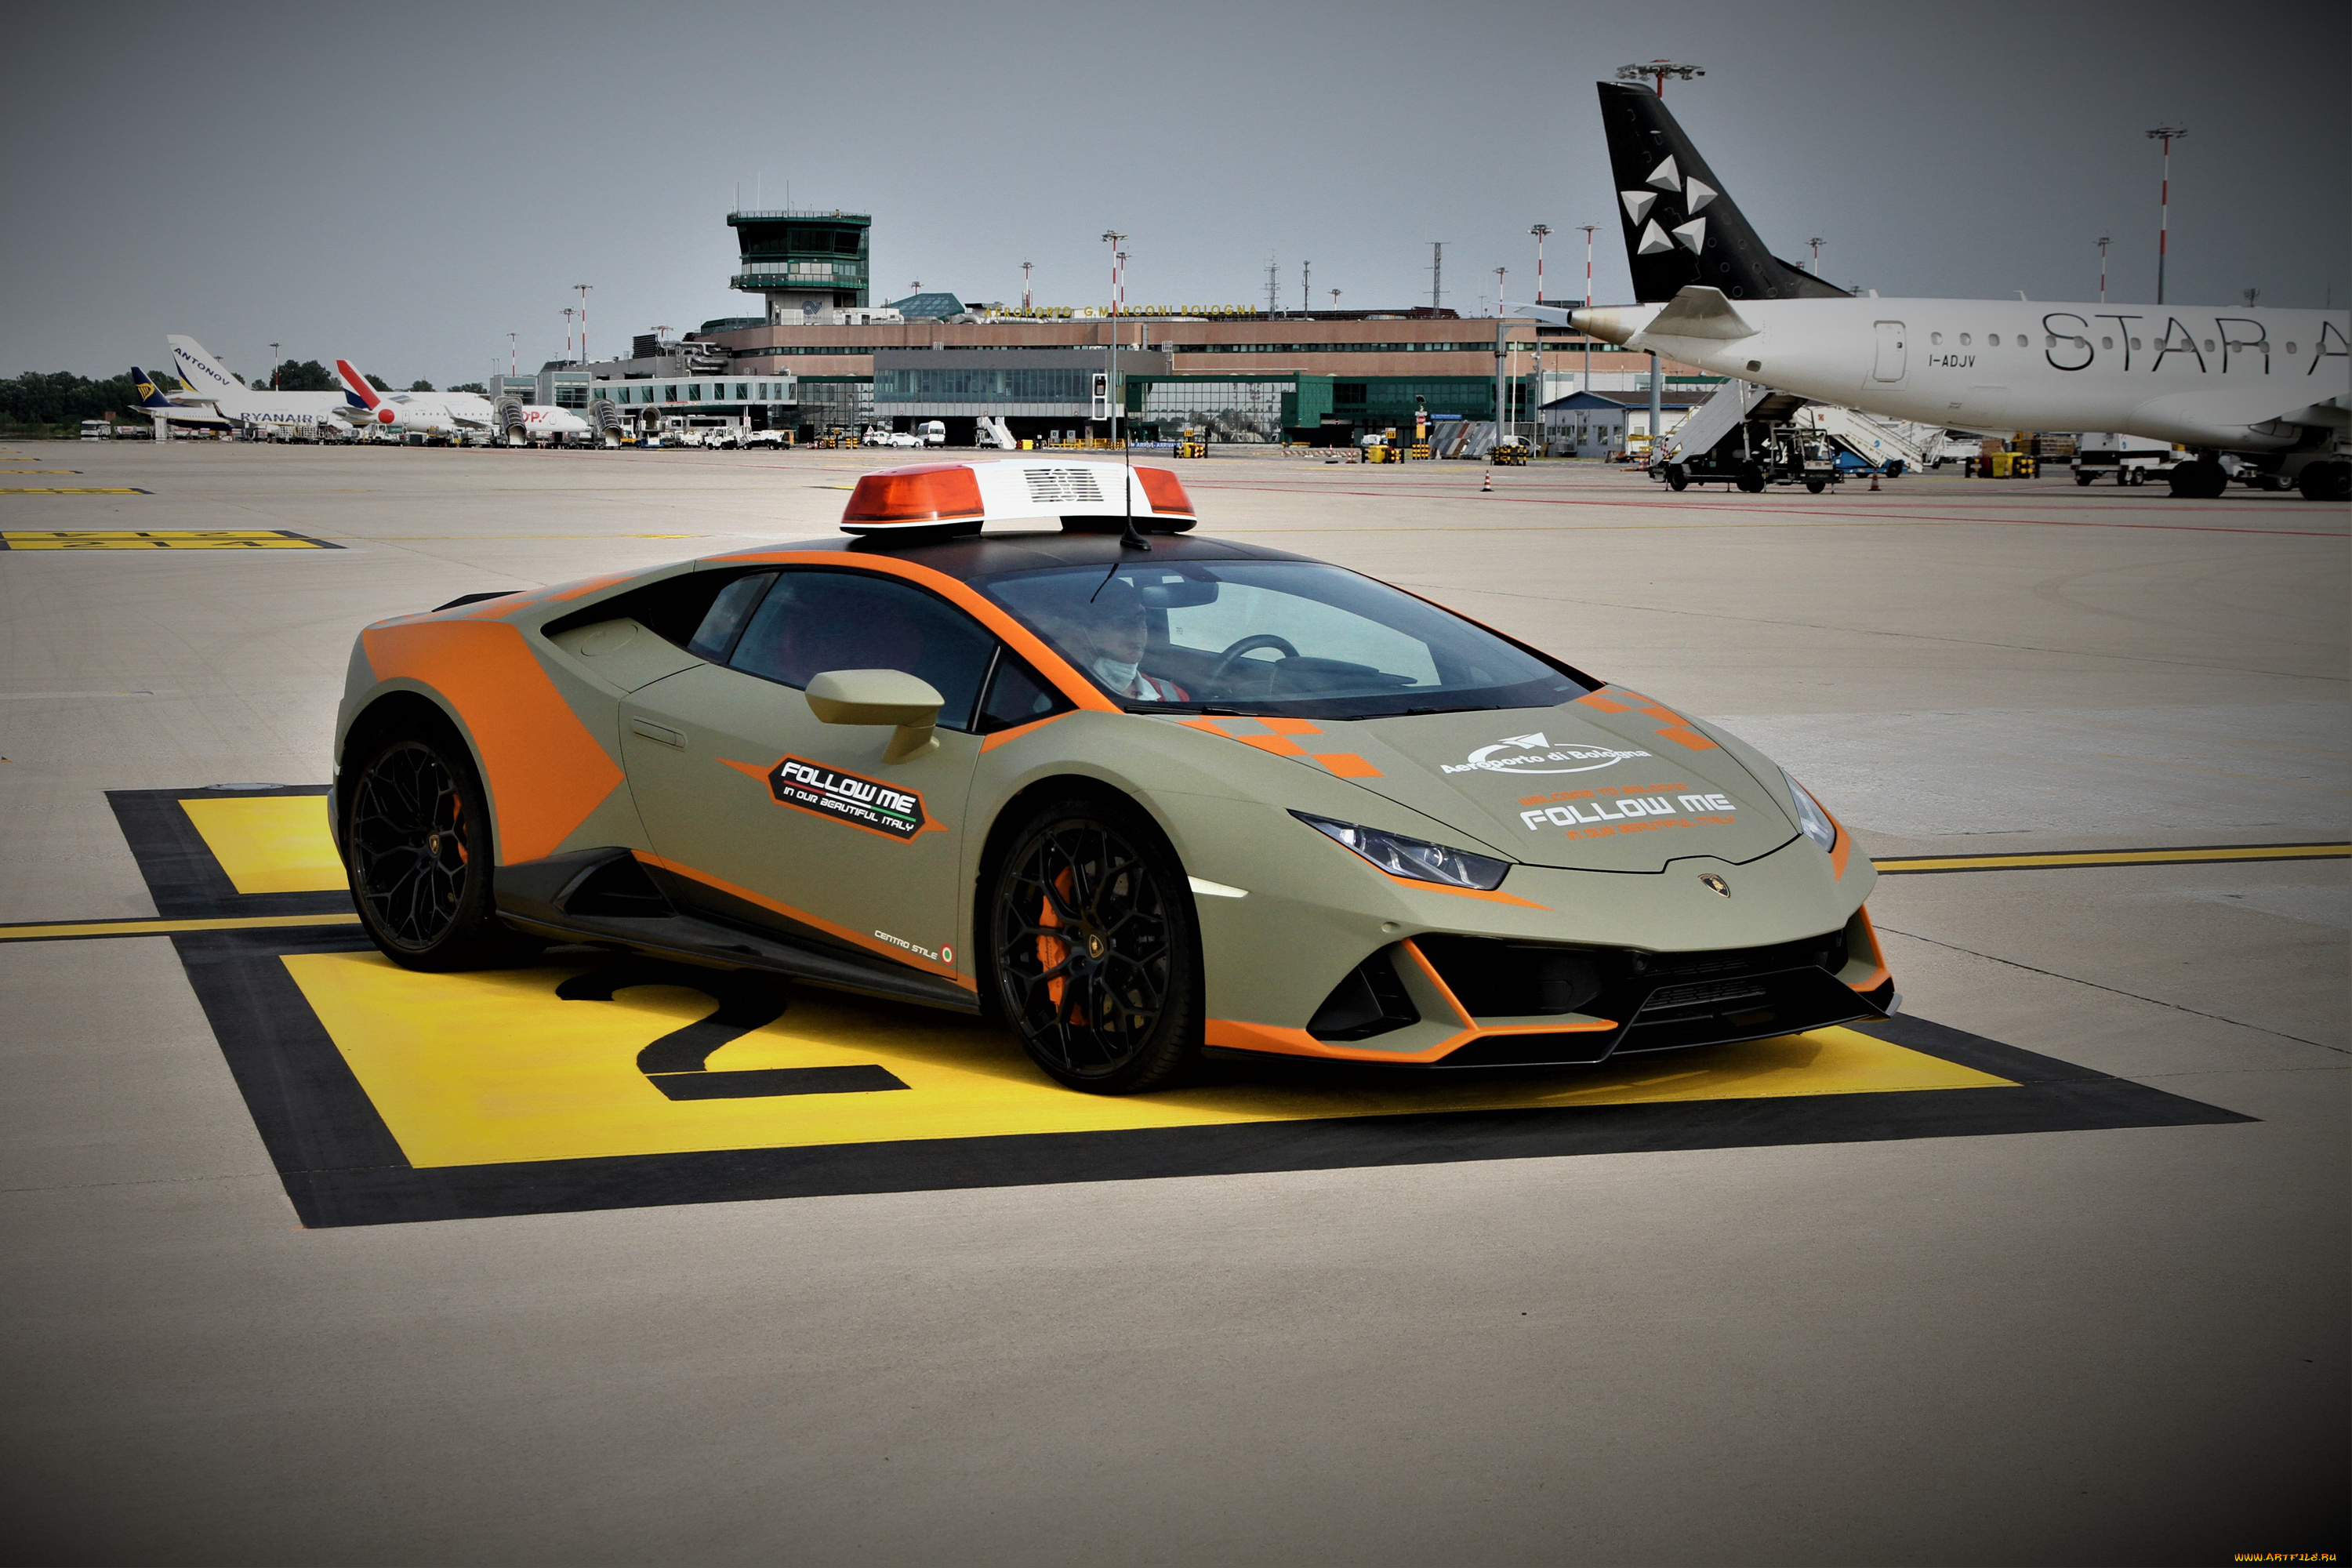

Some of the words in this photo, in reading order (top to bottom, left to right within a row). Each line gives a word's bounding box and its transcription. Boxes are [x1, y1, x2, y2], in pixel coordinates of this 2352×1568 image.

[985, 306, 1072, 318] AEROPORTO
[1181, 304, 1256, 315] BOLOGNA
[2042, 313, 2270, 375] STAR
[173, 347, 230, 386] ANTONOV
[1929, 354, 1976, 368] I-ADJV
[241, 412, 312, 423] RYANAIR
[522, 411, 549, 423] OP!
[1440, 755, 1545, 774] Aeroporto
[1547, 752, 1570, 761] di
[1566, 750, 1652, 760] Bologna
[781, 761, 875, 803] FOLLOW
[876, 792, 916, 814] ME
[784, 786, 793, 797] IN
[797, 790, 818, 804] OUR
[820, 797, 878, 822] BEAUTIFUL
[881, 815, 914, 832] ITALY
[1519, 796, 1676, 831] FOLLOW
[1677, 793, 1737, 812] ME
[874, 930, 910, 949] CENTRO
[911, 944, 938, 960] STILE
